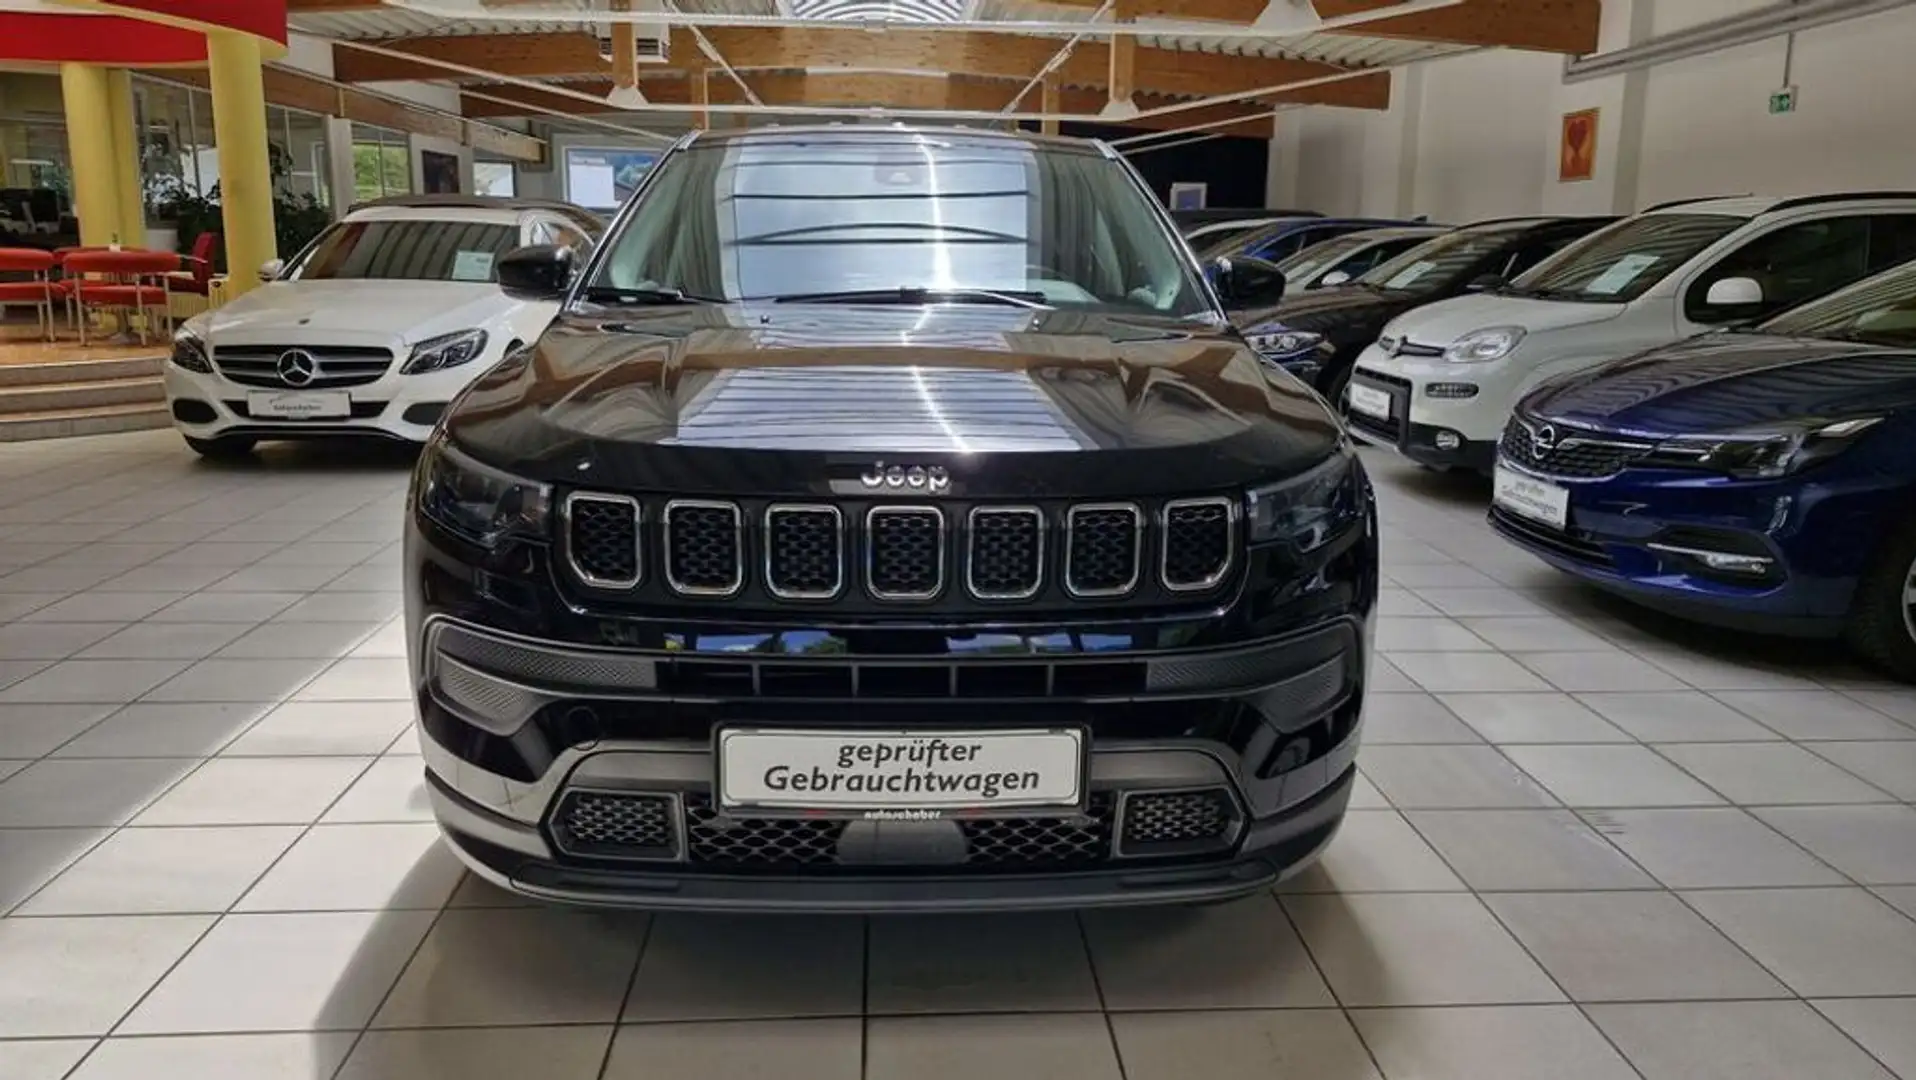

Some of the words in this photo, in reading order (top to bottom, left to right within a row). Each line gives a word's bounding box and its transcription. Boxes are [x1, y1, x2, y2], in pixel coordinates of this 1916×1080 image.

[861, 460, 949, 491] Jeep
[838, 739, 982, 768] geprüfter
[763, 765, 1040, 798] Gebrauchtwagen
